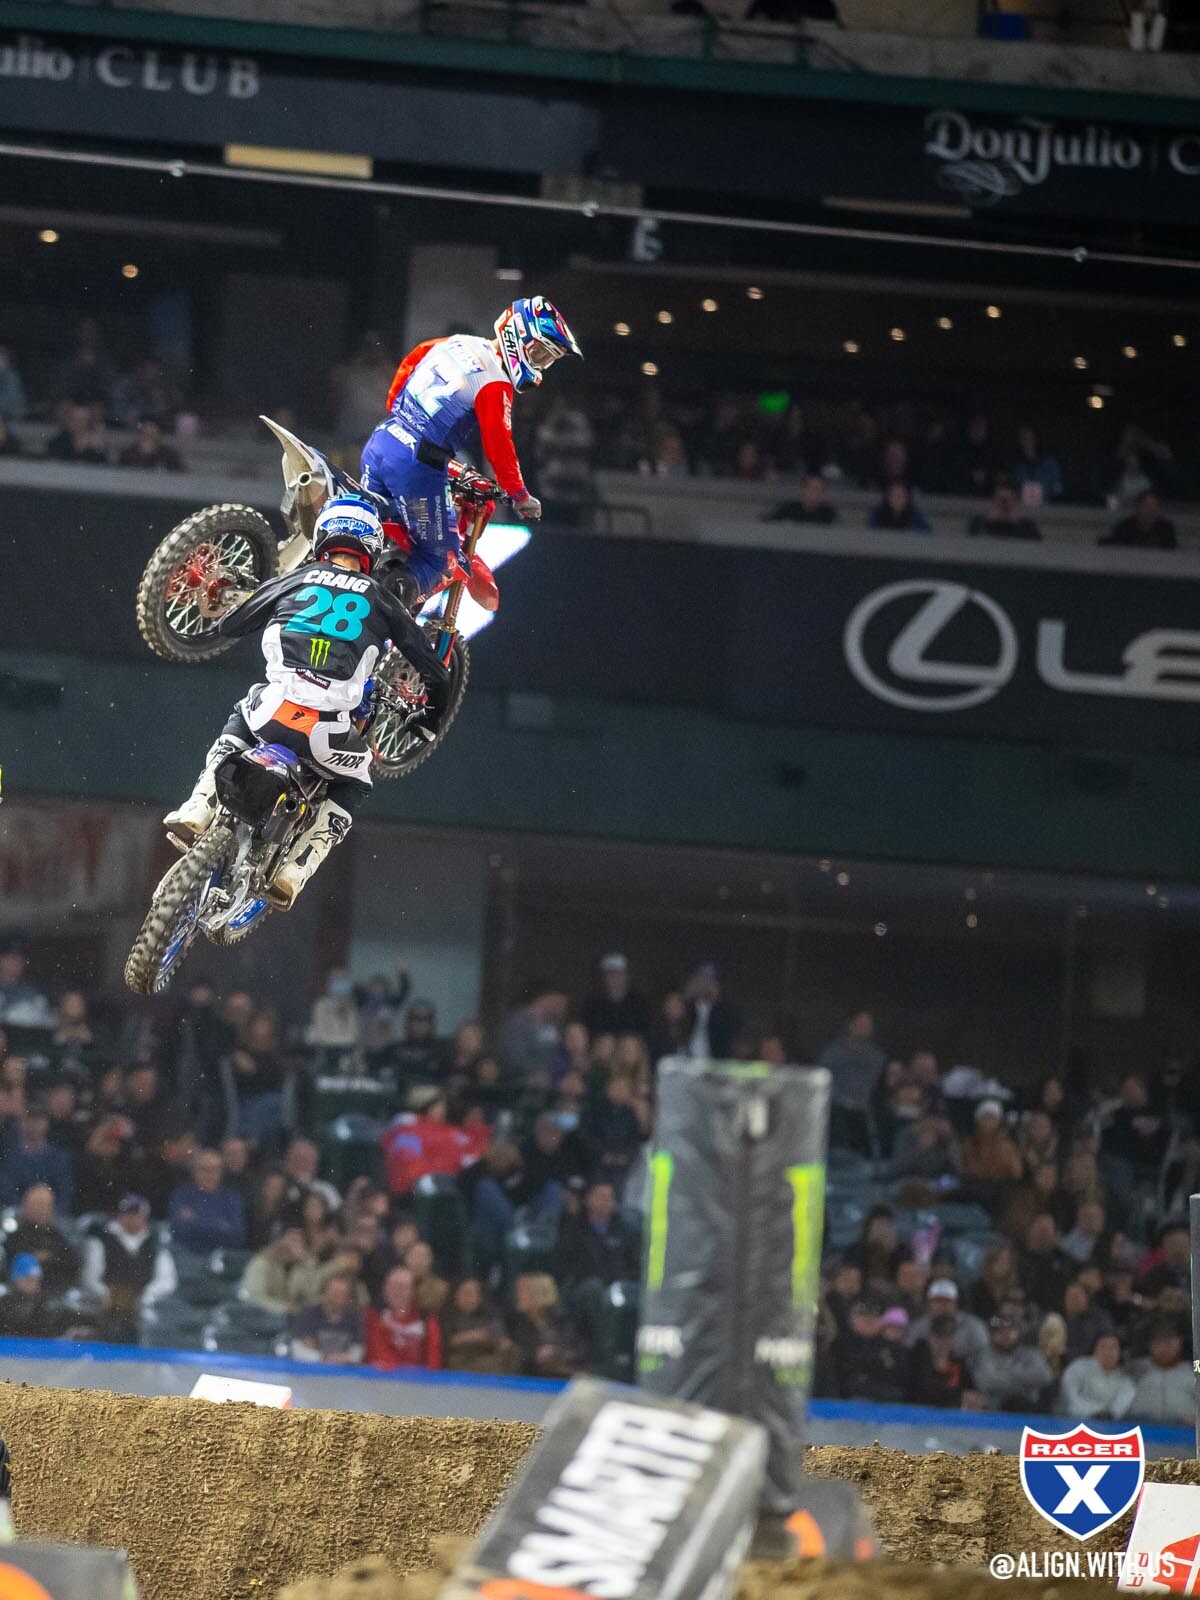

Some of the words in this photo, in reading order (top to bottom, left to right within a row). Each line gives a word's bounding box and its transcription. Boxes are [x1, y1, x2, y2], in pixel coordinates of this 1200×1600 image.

[97, 46, 261, 99] CLUB
[328, 517, 367, 533] CHRISTIAN
[303, 569, 371, 593] CRAIG
[285, 585, 371, 641] 28
[325, 752, 366, 769] THOR
